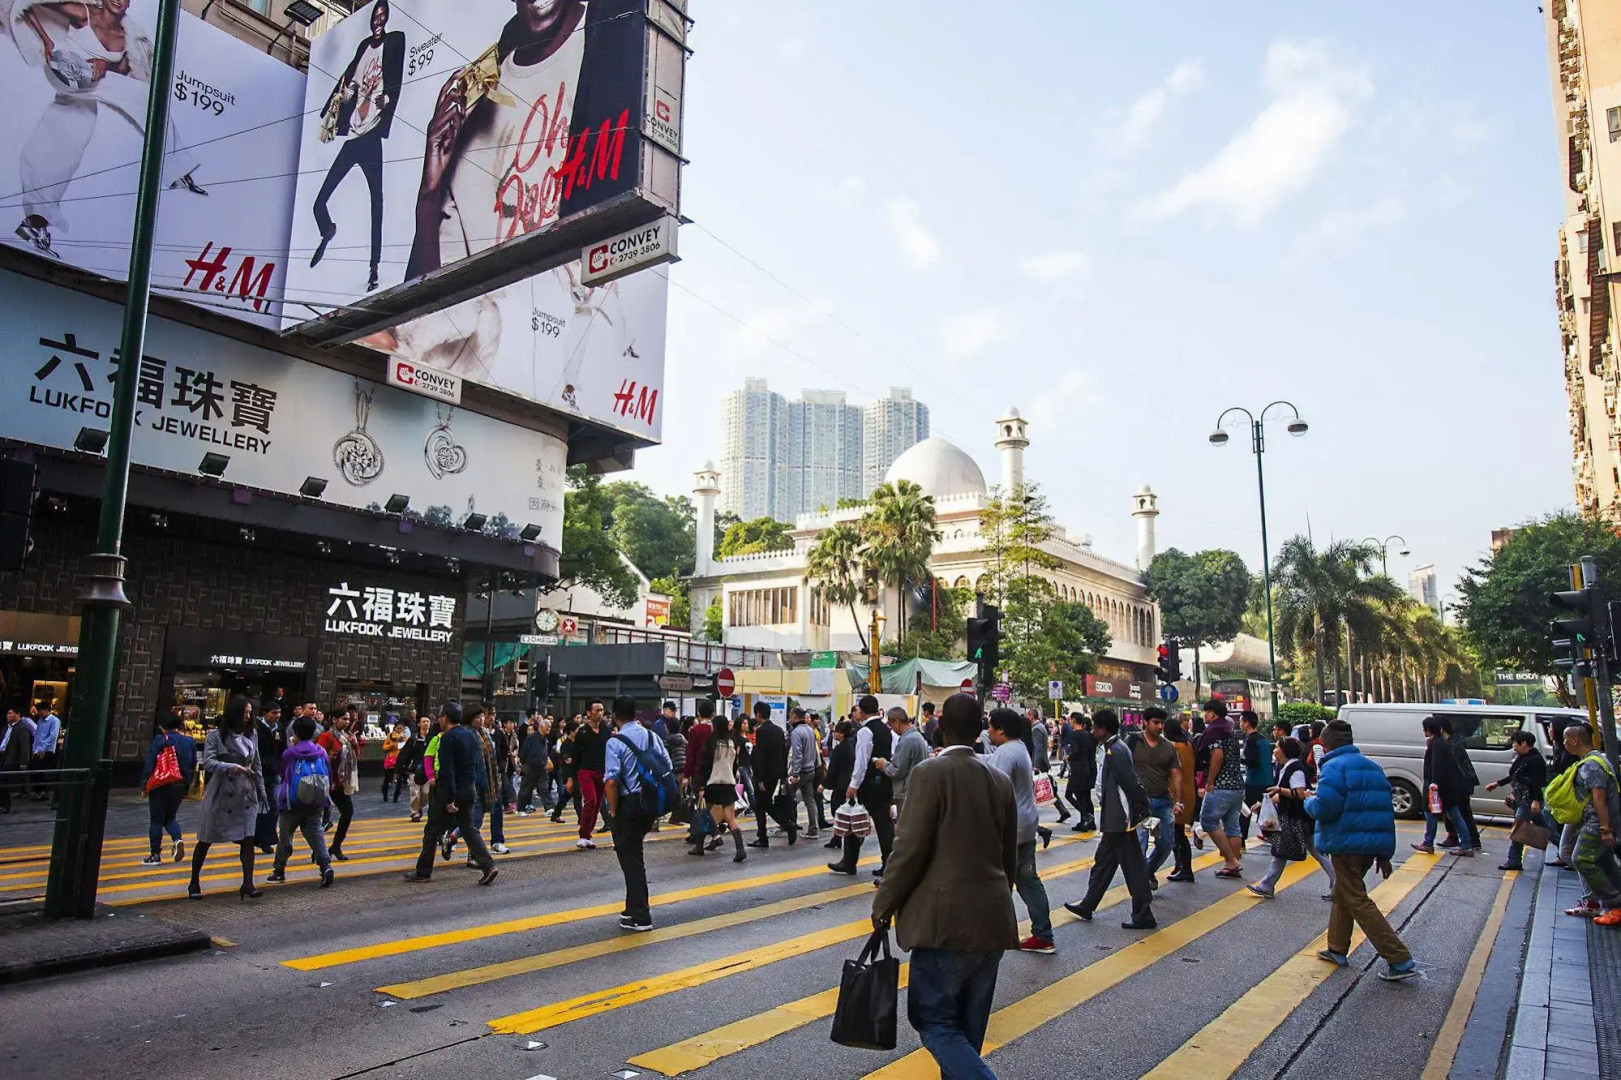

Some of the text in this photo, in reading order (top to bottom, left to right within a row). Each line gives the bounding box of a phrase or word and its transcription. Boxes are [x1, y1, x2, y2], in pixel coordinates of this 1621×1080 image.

[409, 32, 443, 58] Sweater
[407, 49, 434, 77] $99
[174, 82, 224, 116] $199
[176, 70, 236, 106] Jumpsuit
[515, 81, 568, 173] Oh
[645, 113, 678, 140] CONVEY
[553, 108, 630, 201] H&M
[610, 226, 661, 254] CONVEY
[618, 241, 660, 263] 2739 3806
[183, 241, 275, 312] H&M
[531, 307, 566, 328] Jumpsuit
[531, 316, 560, 338] $199
[415, 369, 455, 390] CONVEY
[422, 382, 455, 398] 2739 3806
[613, 378, 658, 426] H&M
[30, 385, 272, 454] LUKFOK JEWELLERY
[326, 582, 456, 629] 六福珠寶
[325, 619, 453, 643] LUKFOOK JEWELLERY
[531, 636, 557, 644] OMEGA
[17, 643, 54, 652] LUKFOOK
[245, 658, 272, 666] LUKFOOK
[273, 660, 305, 668] JEWELLERY
[1497, 673, 1514, 681] THE
[1516, 673, 1539, 681] BODY
